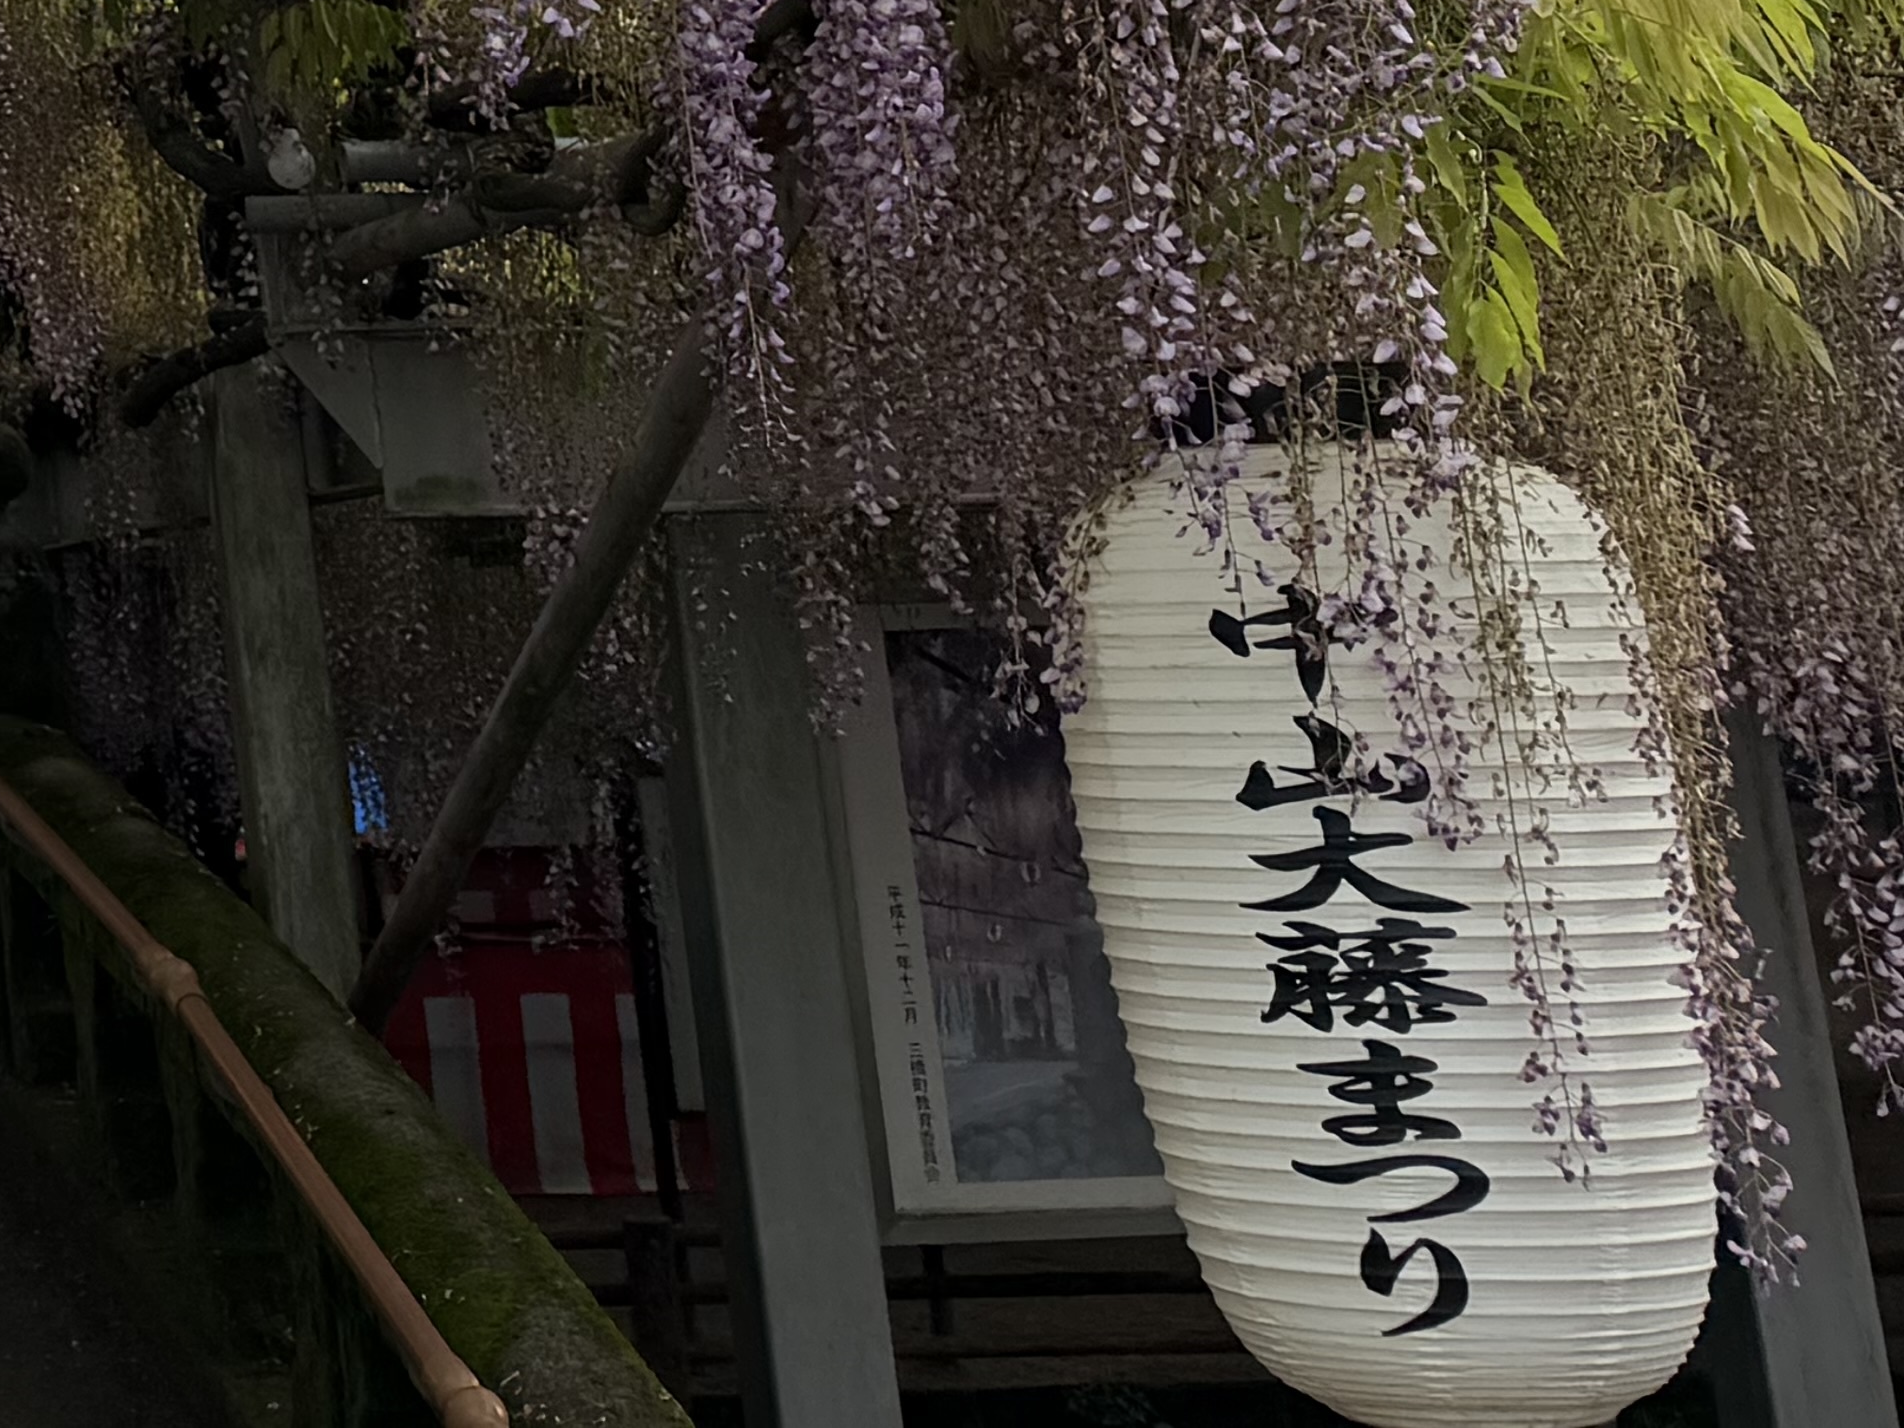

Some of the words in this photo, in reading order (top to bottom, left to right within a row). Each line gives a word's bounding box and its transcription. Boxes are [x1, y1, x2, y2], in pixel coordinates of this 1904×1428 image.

[1208, 583, 1491, 1336] 中山大藤まつり
